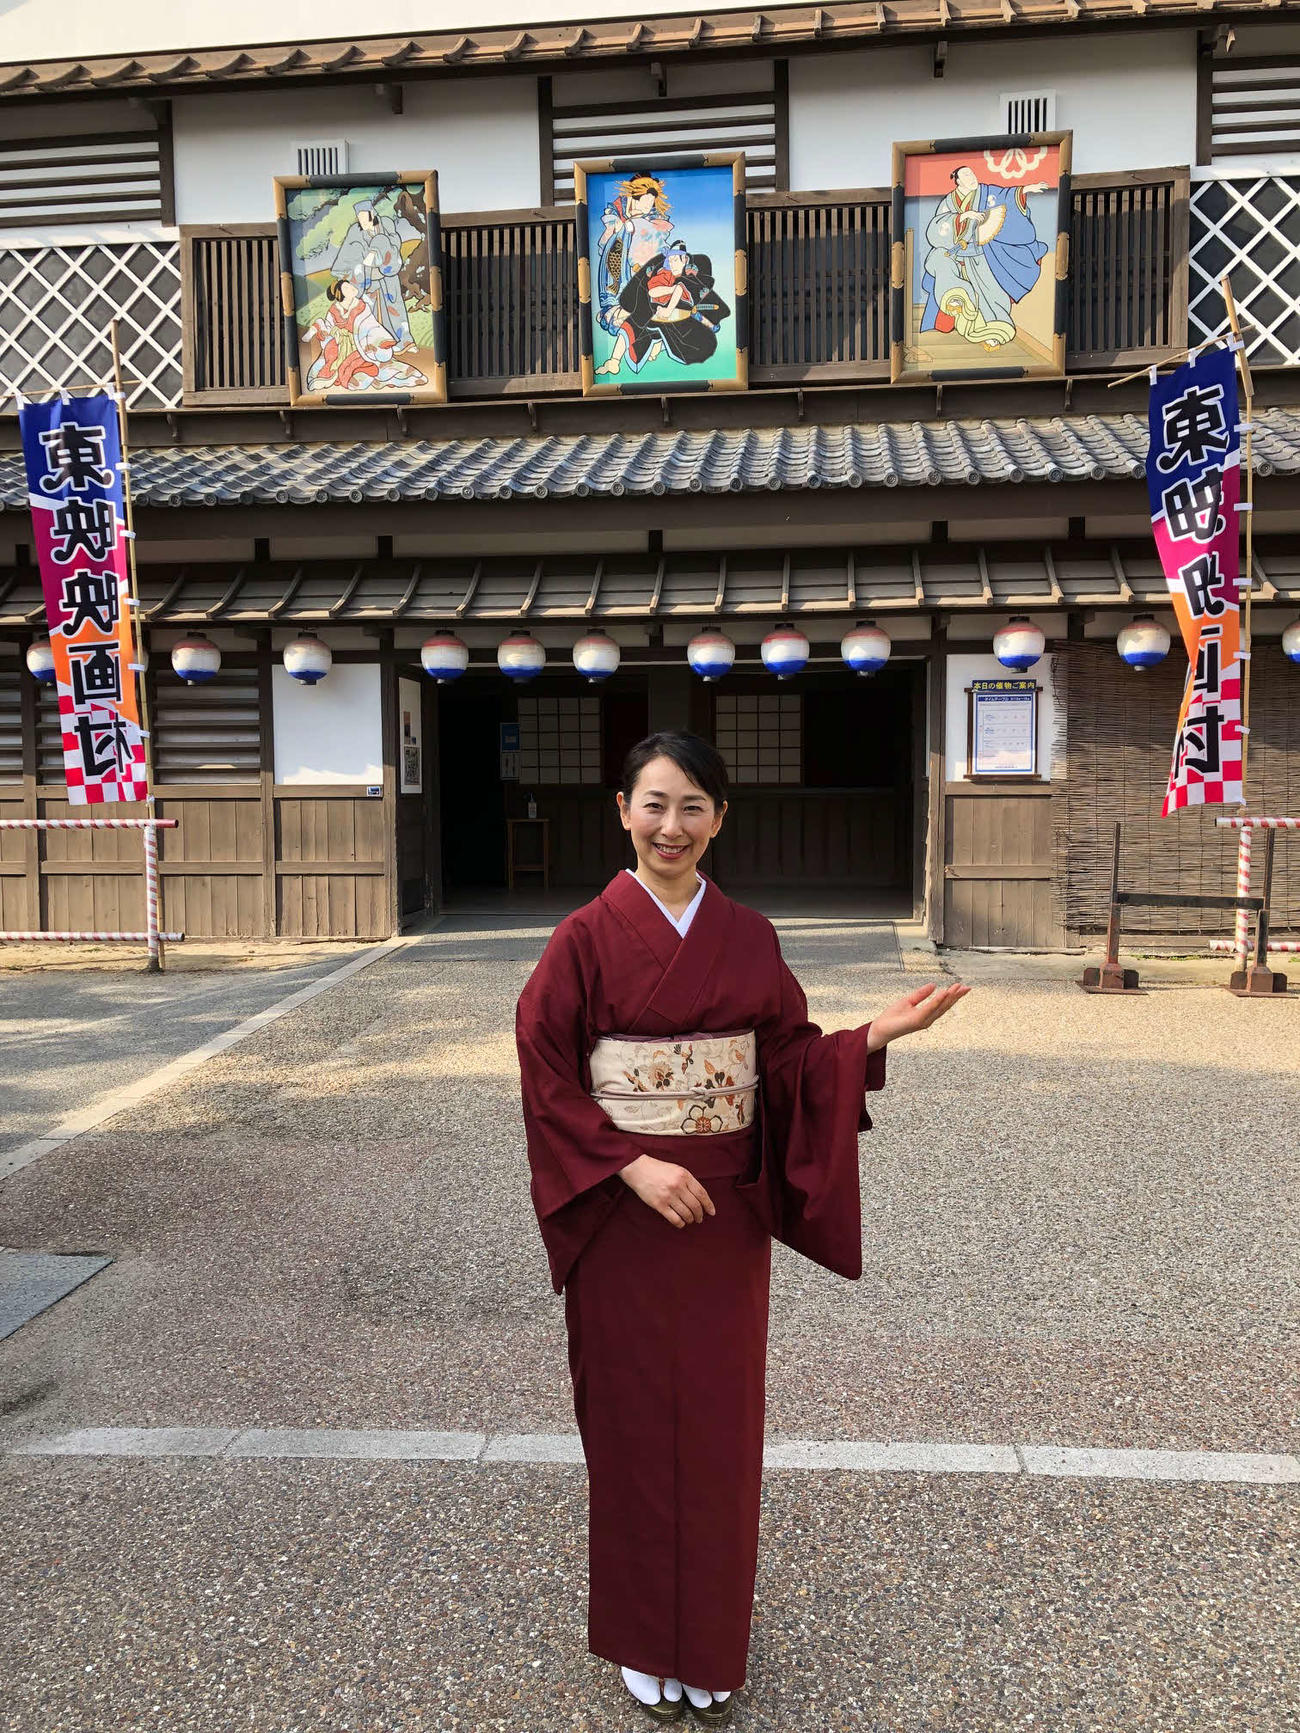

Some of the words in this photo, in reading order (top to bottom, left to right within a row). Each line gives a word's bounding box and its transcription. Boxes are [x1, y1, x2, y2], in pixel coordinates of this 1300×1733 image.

[973, 681, 1035, 690] 本日の催物ご案内
